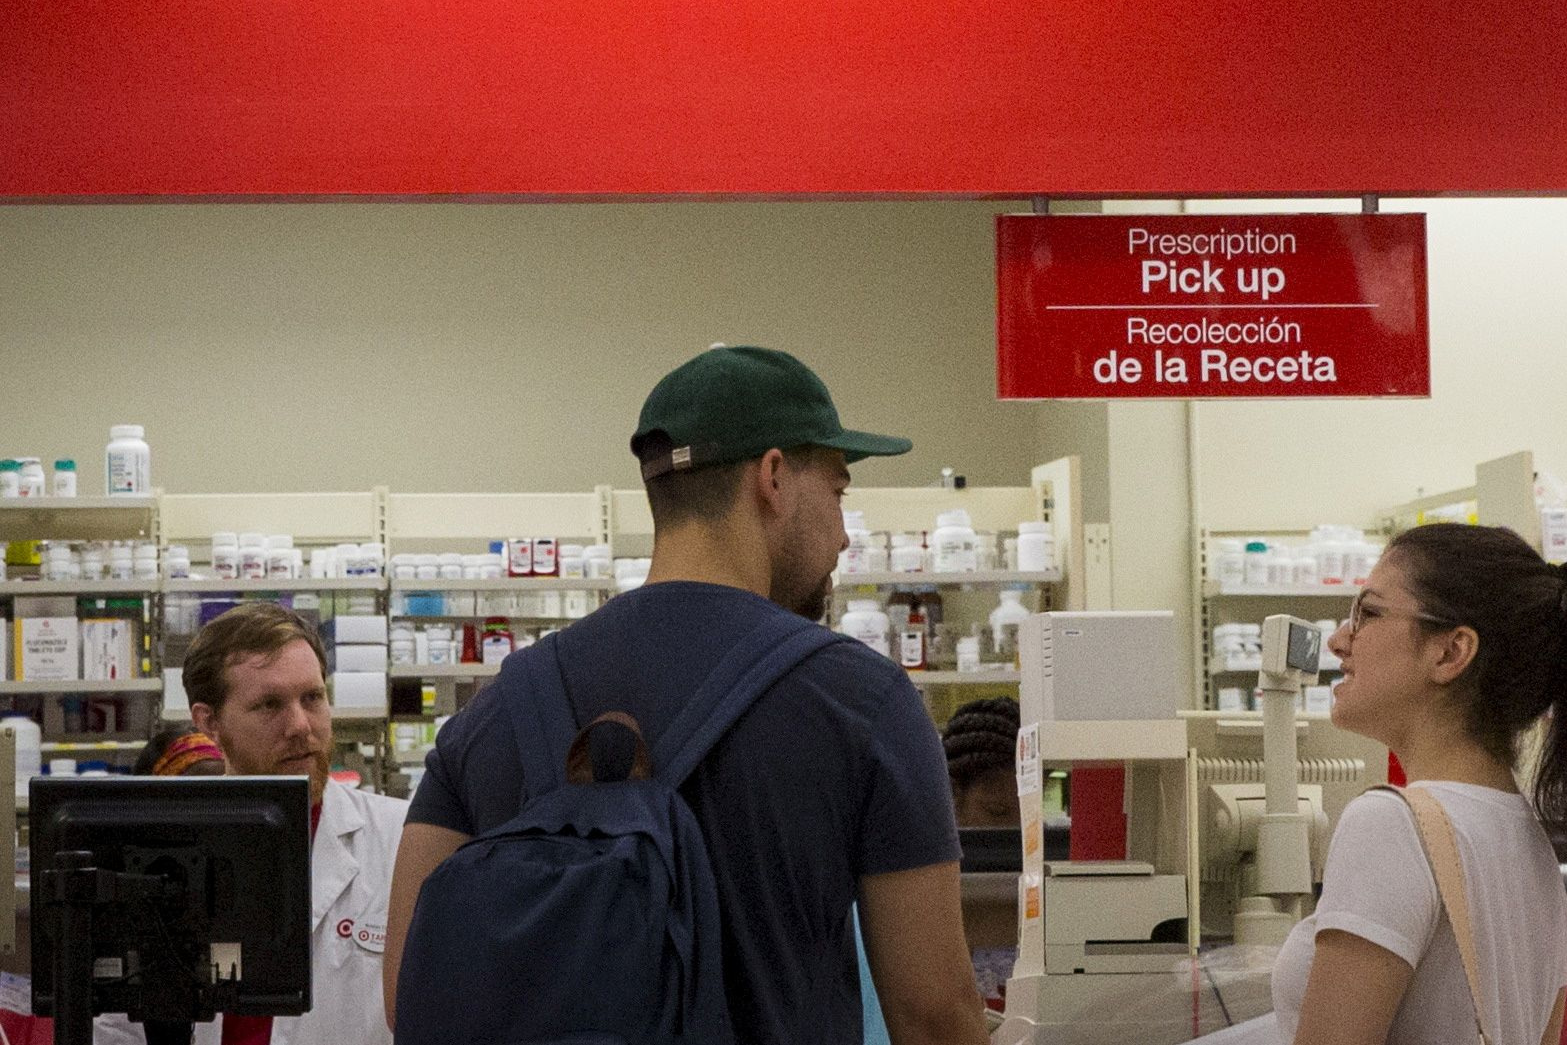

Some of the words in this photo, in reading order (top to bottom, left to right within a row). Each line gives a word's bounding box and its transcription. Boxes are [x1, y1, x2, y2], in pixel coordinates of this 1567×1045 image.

[1128, 228, 1297, 260] Prescription
[1141, 261, 1224, 294] Pick
[1237, 267, 1286, 299] up
[1127, 317, 1301, 344] Recolección
[1093, 351, 1142, 383] de
[1155, 351, 1188, 383] la
[1201, 350, 1338, 383] Receta
